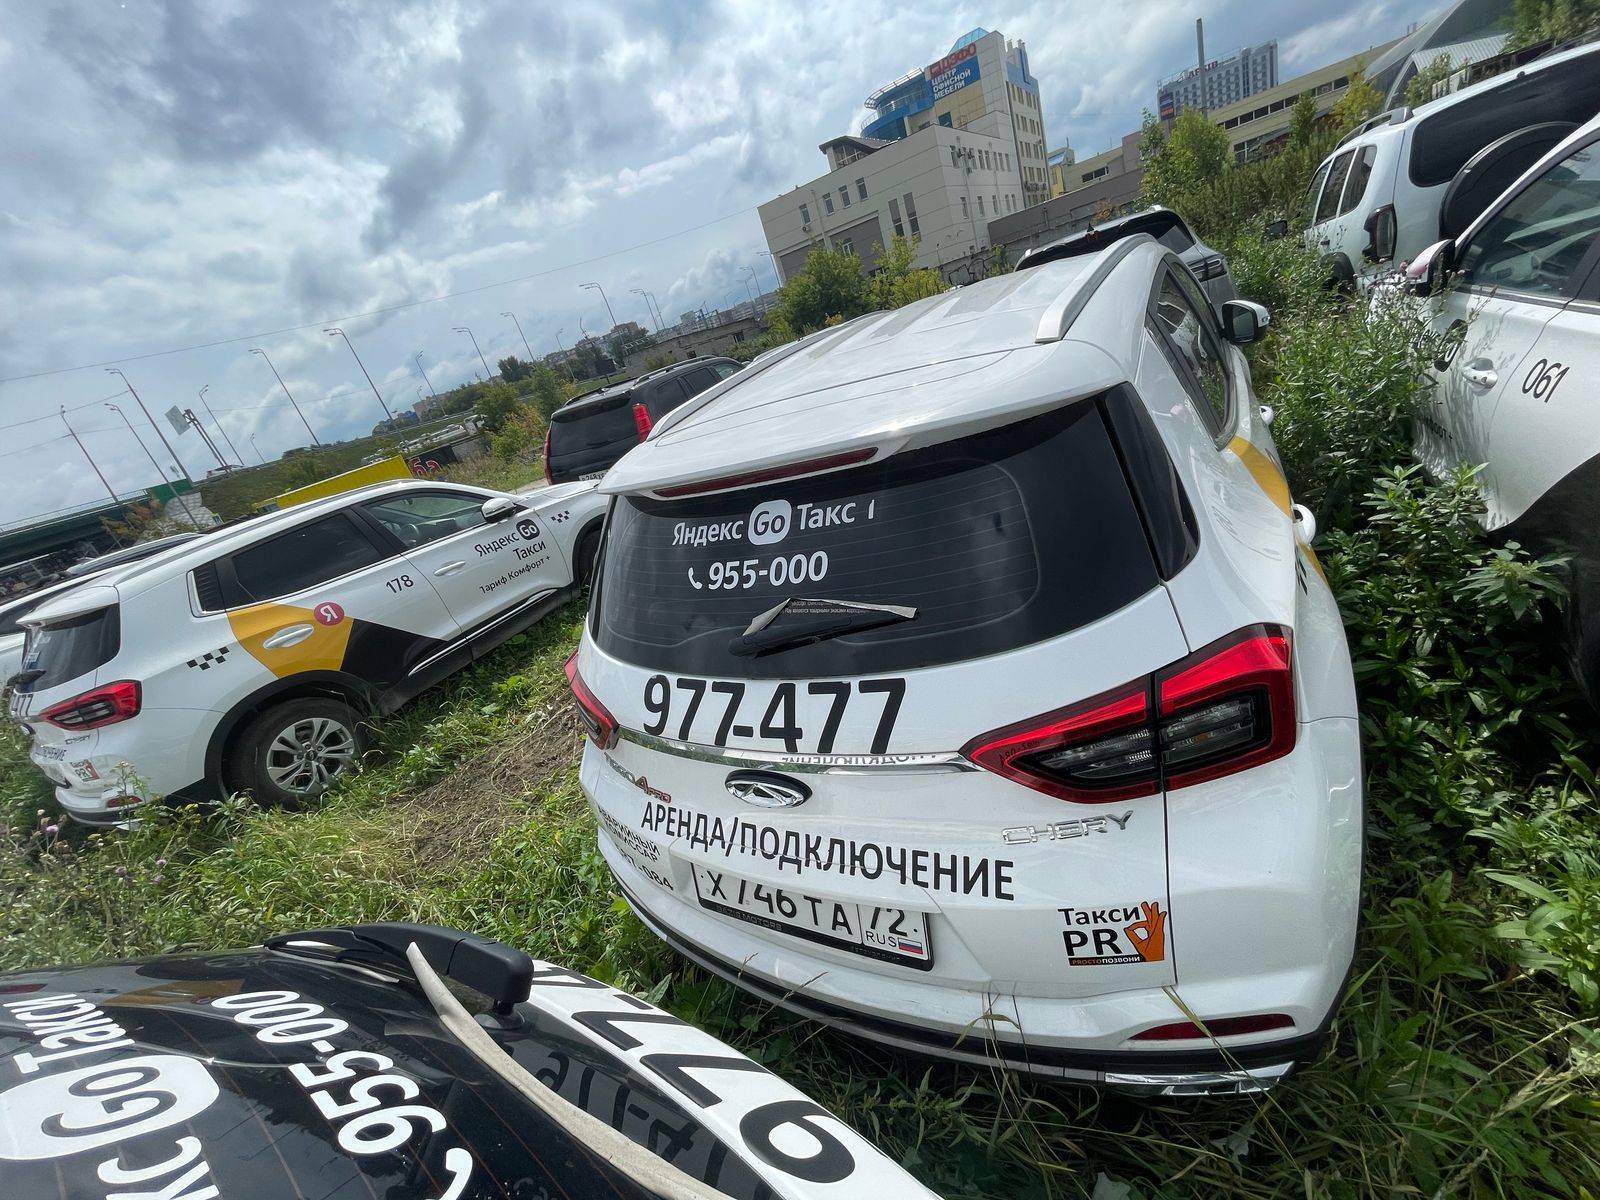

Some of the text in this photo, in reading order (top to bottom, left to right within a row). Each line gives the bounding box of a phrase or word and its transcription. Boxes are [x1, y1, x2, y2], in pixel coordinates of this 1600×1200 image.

[931, 68, 957, 86] ЦЕНТР
[933, 68, 971, 92] ОФИСНОЙ
[934, 80, 965, 100] МЕБЕЛИ
[1522, 358, 1570, 403] 061
[474, 532, 519, 557] Яндекс
[672, 520, 743, 547] Яндекс
[512, 541, 546, 560] Такси
[479, 576, 507, 594] Тариф
[507, 558, 545, 580] Комфорт
[708, 550, 829, 590] 955-000
[386, 574, 414, 594] 178
[320, 604, 338, 622] Я
[643, 674, 906, 754] 977-477
[1002, 810, 1133, 845] CHERY
[641, 801, 1014, 901] АРЕНДА/ПОДКЛЮЧЕНИЕ
[1058, 906, 1141, 926] Такси
[866, 930, 897, 947] RUS
[2, 993, 136, 1074] Такси
[211, 990, 447, 1155] 955-000
